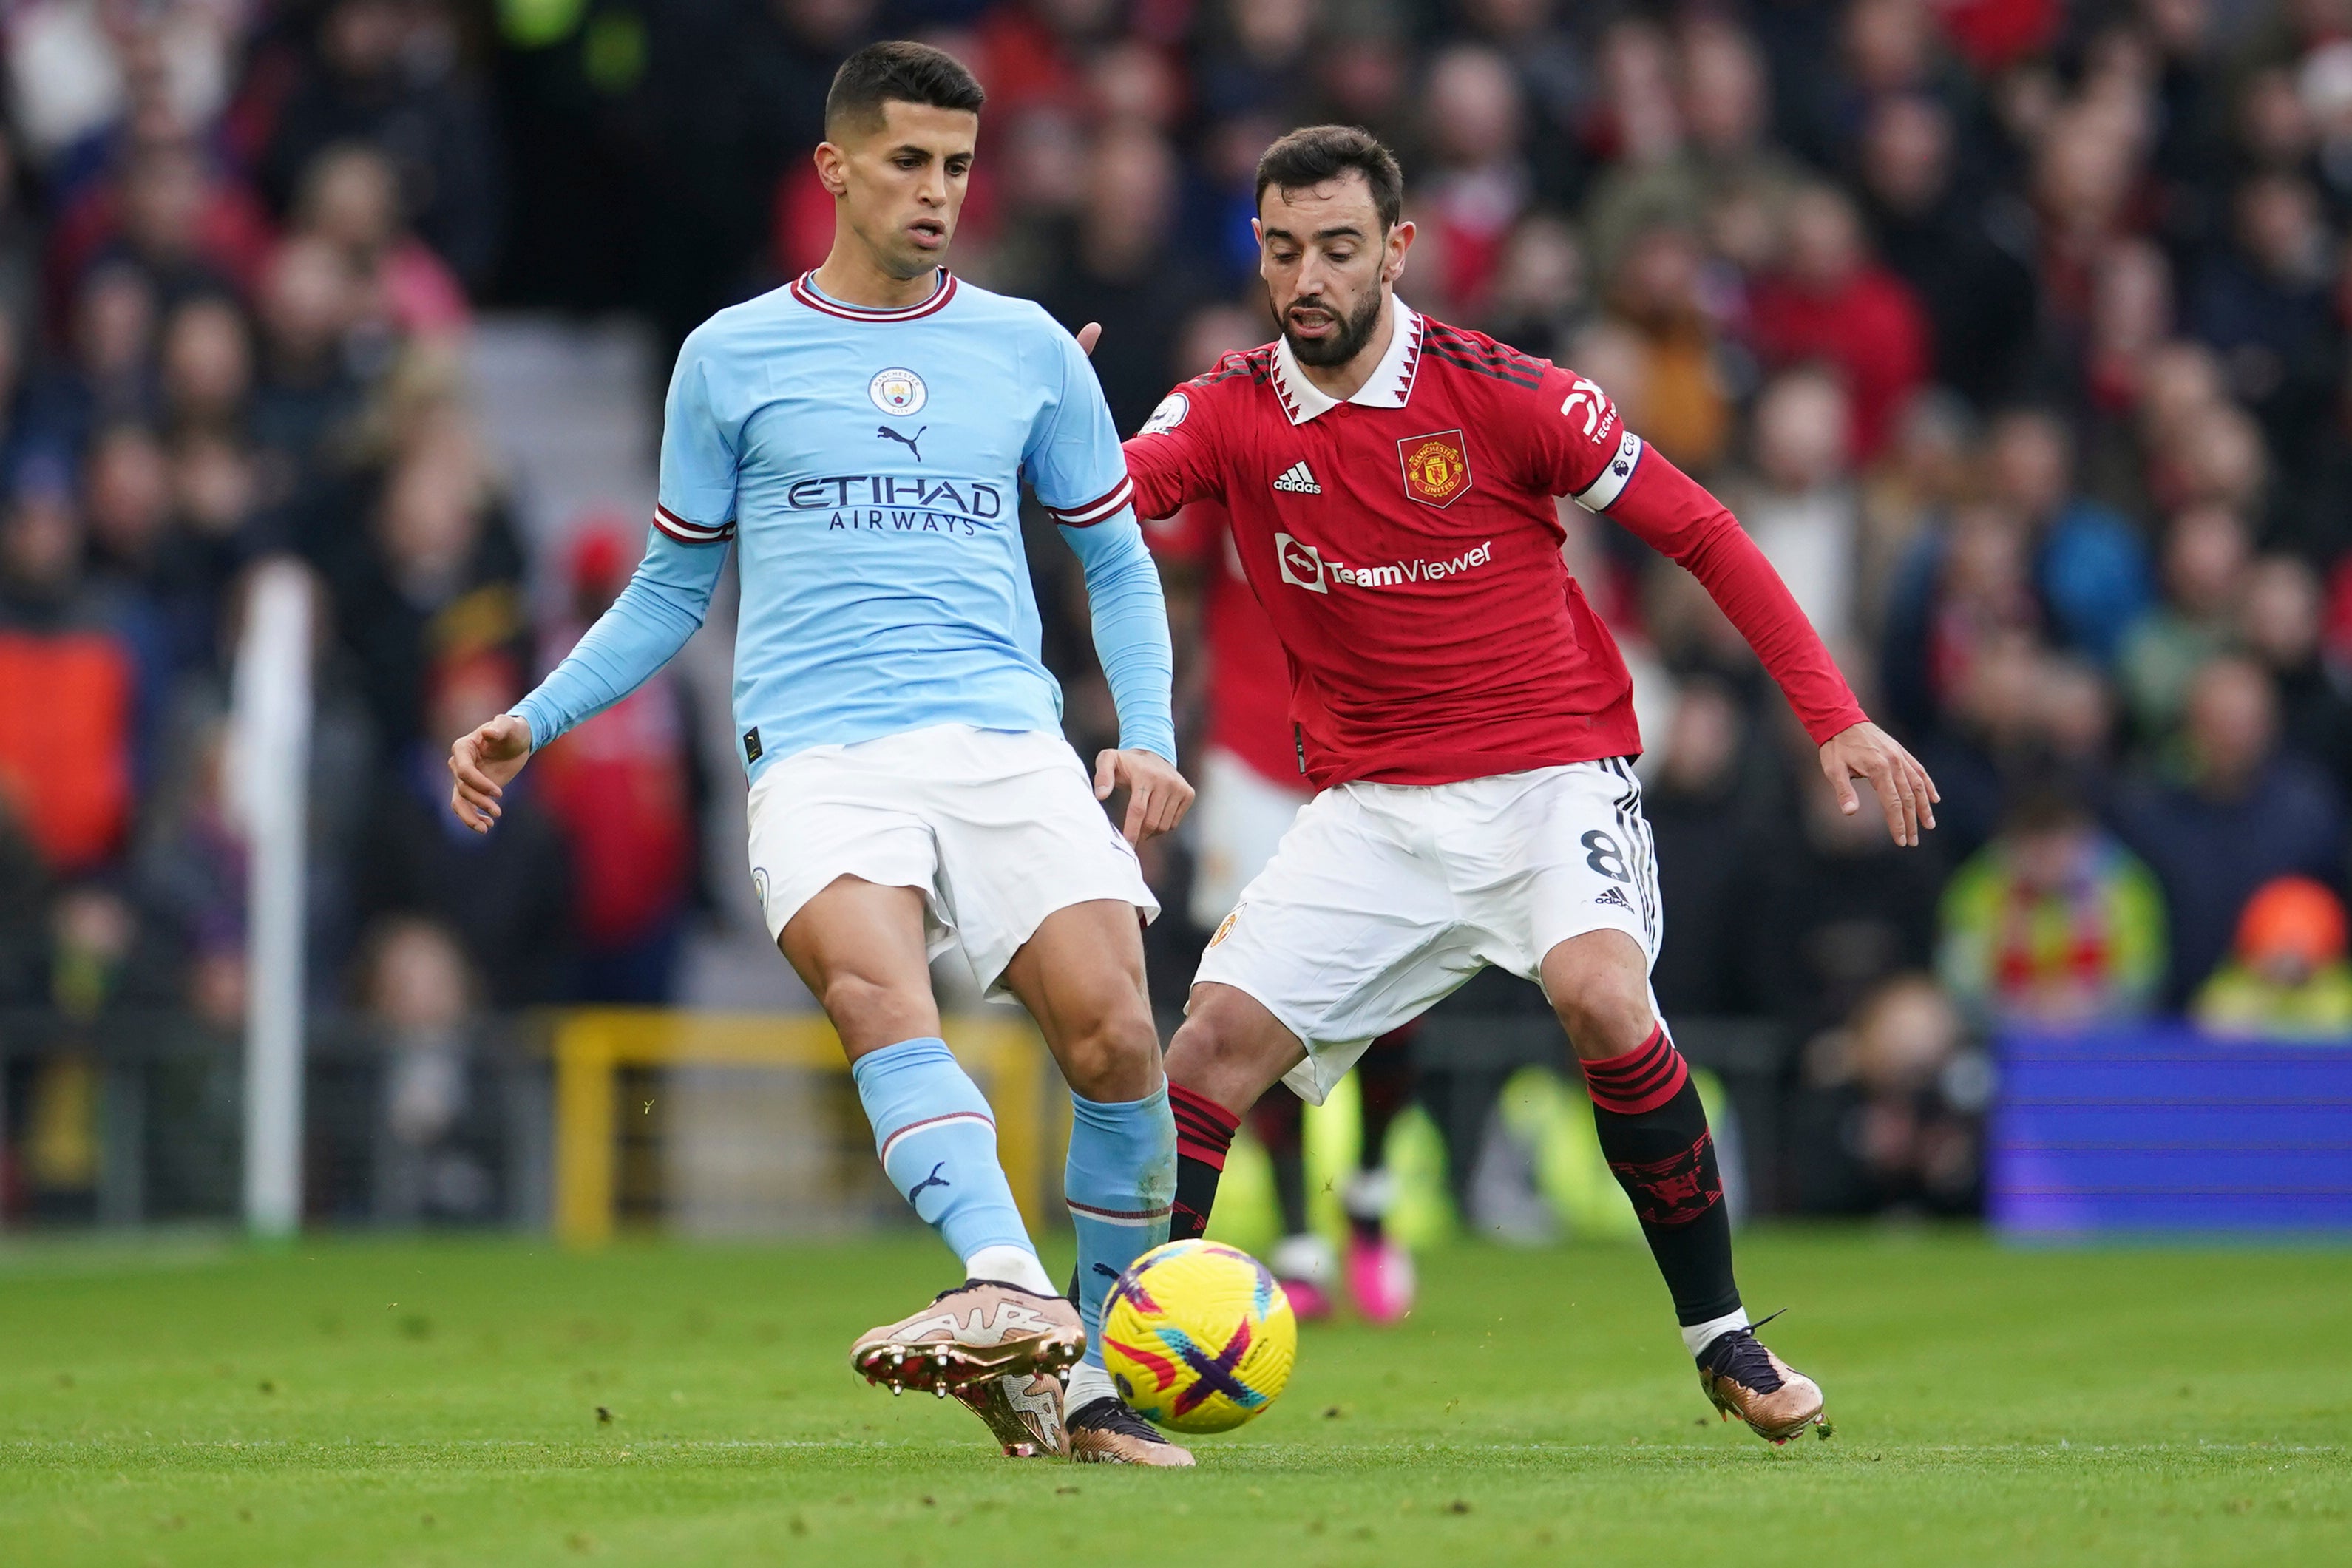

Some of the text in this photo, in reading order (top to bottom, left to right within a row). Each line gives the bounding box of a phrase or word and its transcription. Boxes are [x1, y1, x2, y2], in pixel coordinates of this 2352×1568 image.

[875, 372, 920, 386] MANCHESTER
[1413, 445, 1456, 467] MANCHESTER
[788, 475, 1000, 519] ETIHAD
[1273, 480, 1322, 495] adidas
[1424, 481, 1454, 493] UNITED
[829, 509, 975, 536] AIRWAYS
[1324, 540, 1492, 588] TeamViewer
[1581, 829, 1631, 883] 8
